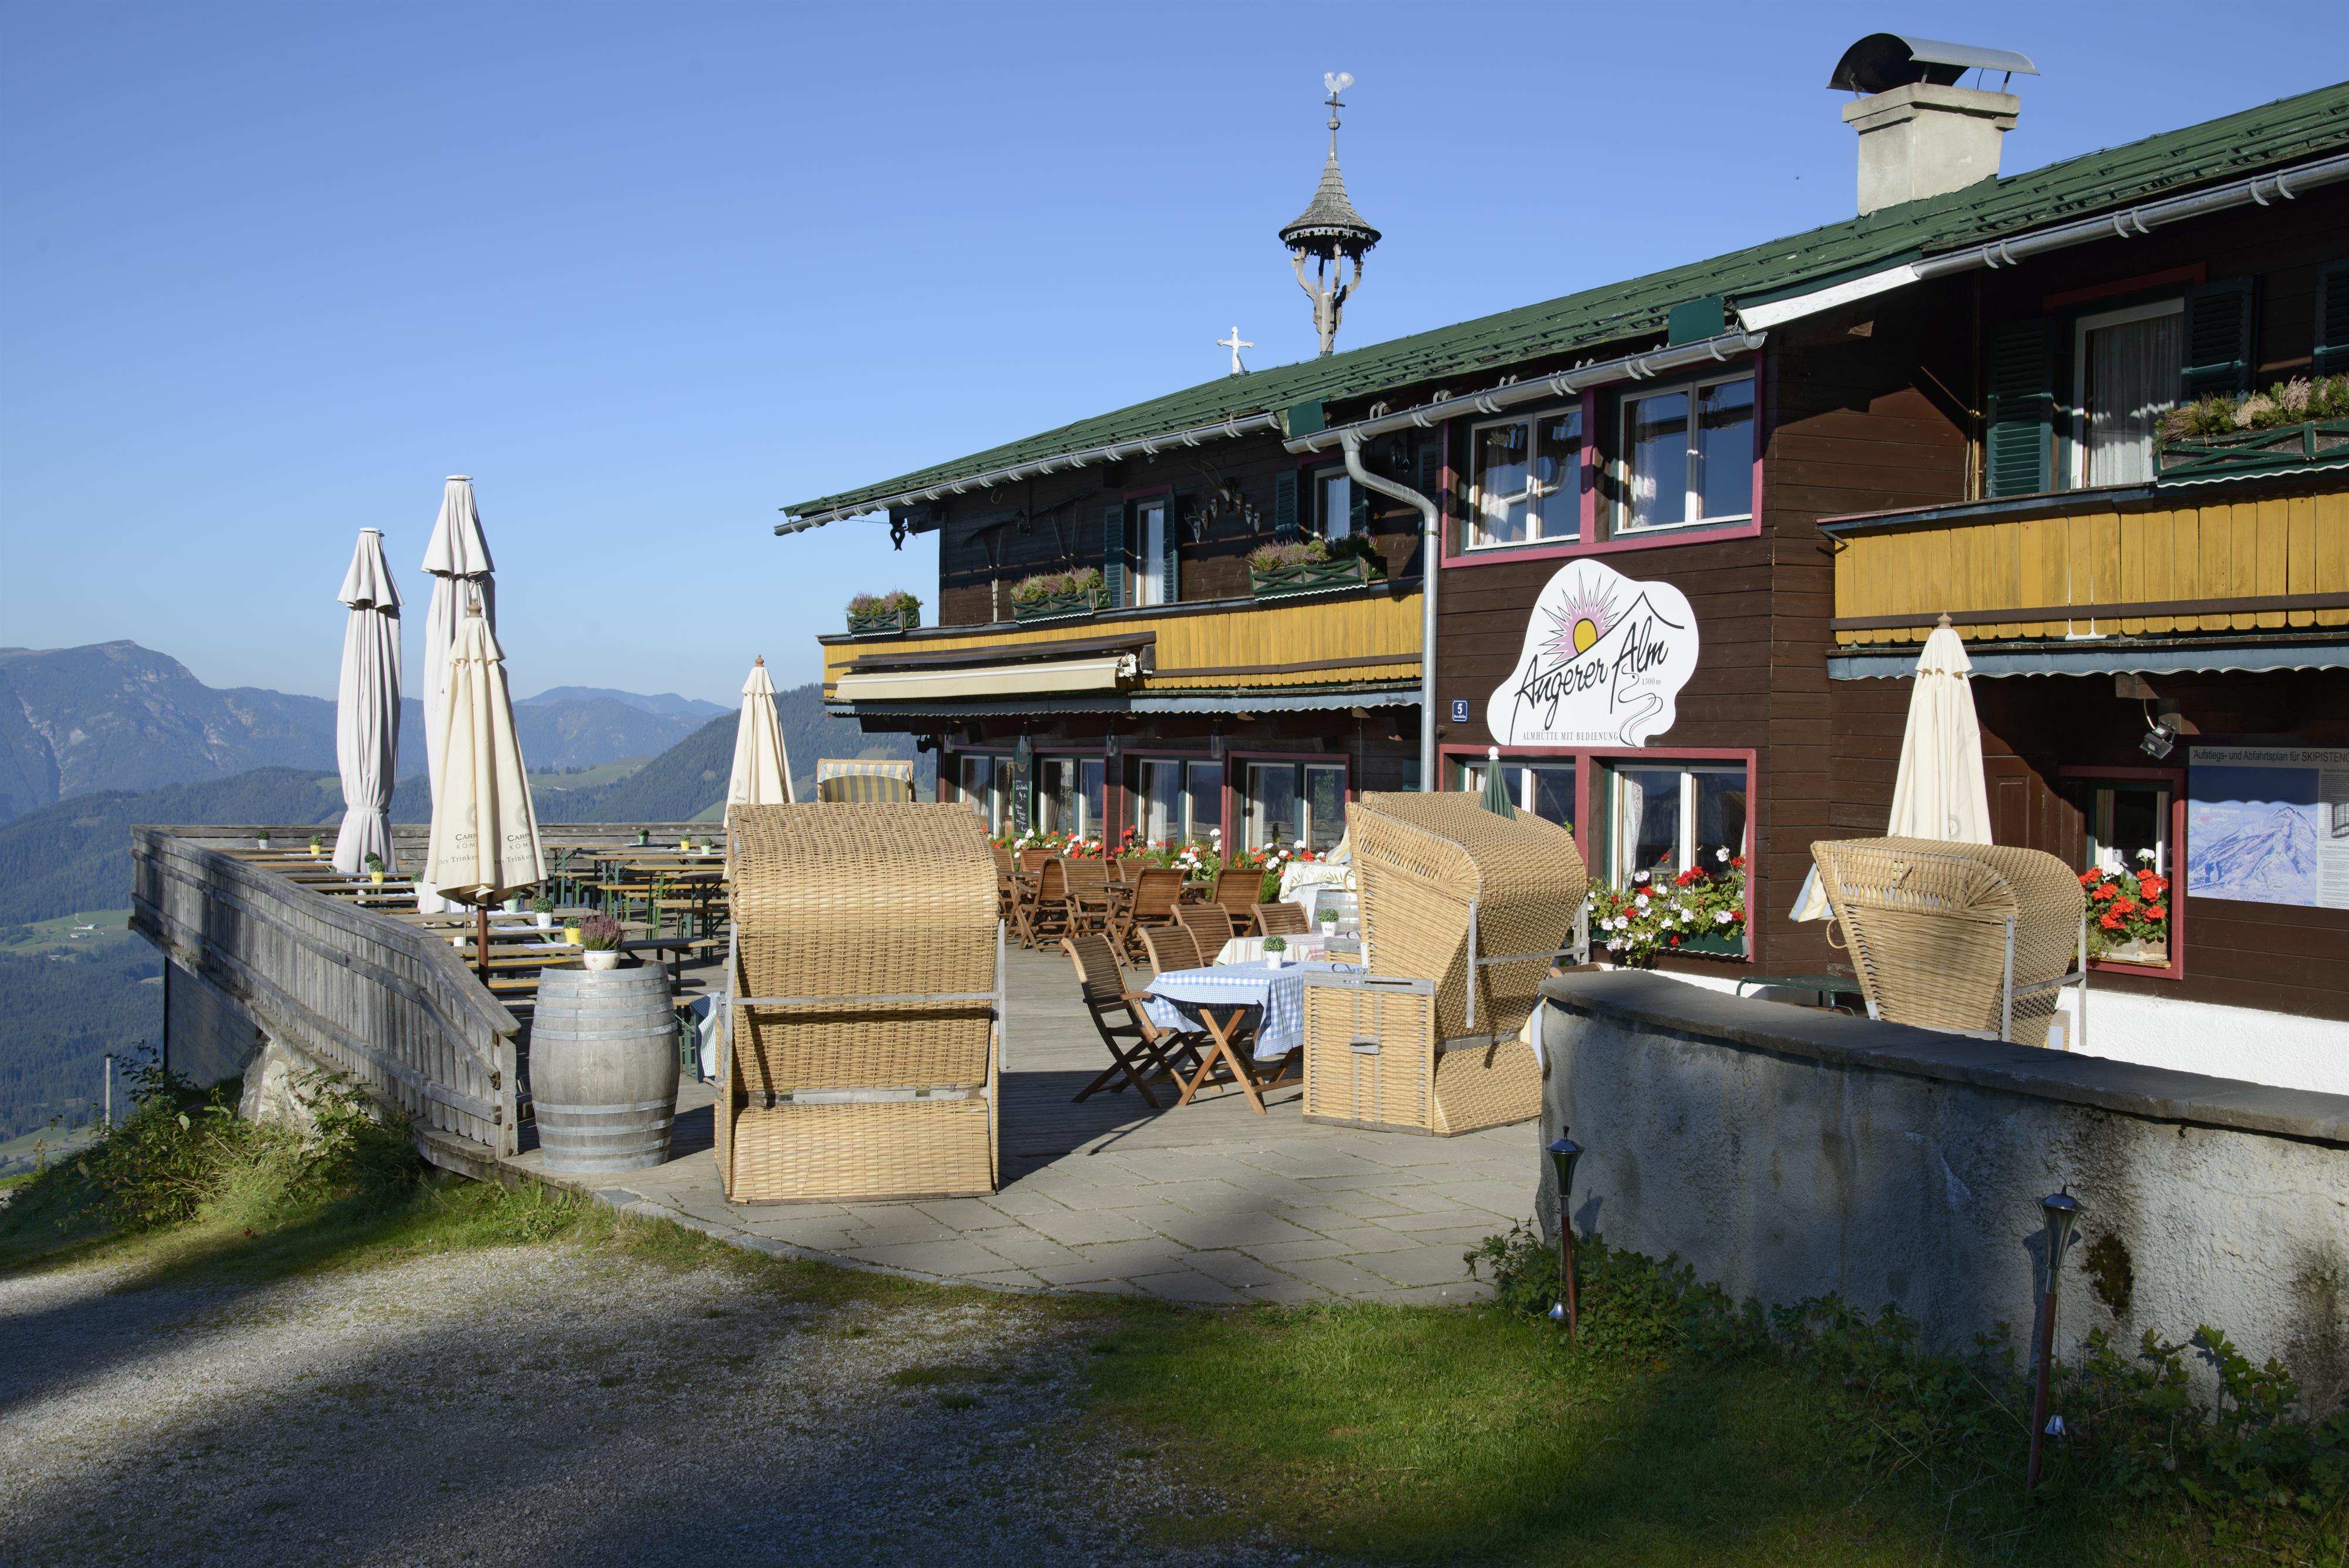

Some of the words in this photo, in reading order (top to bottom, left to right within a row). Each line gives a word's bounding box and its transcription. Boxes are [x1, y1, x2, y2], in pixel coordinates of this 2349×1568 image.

[1509, 654, 1608, 745] Angerer
[1610, 615, 1669, 715] Alm
[1457, 703, 1463, 715] 5
[1561, 732, 1574, 741] MIT
[1576, 732, 1618, 741] BEDIENUNG
[2193, 749, 2227, 762] Aufstiegs-
[2229, 751, 2242, 760] und
[2243, 750, 2288, 763] Abfahrtsplan
[2290, 751, 2300, 761] für
